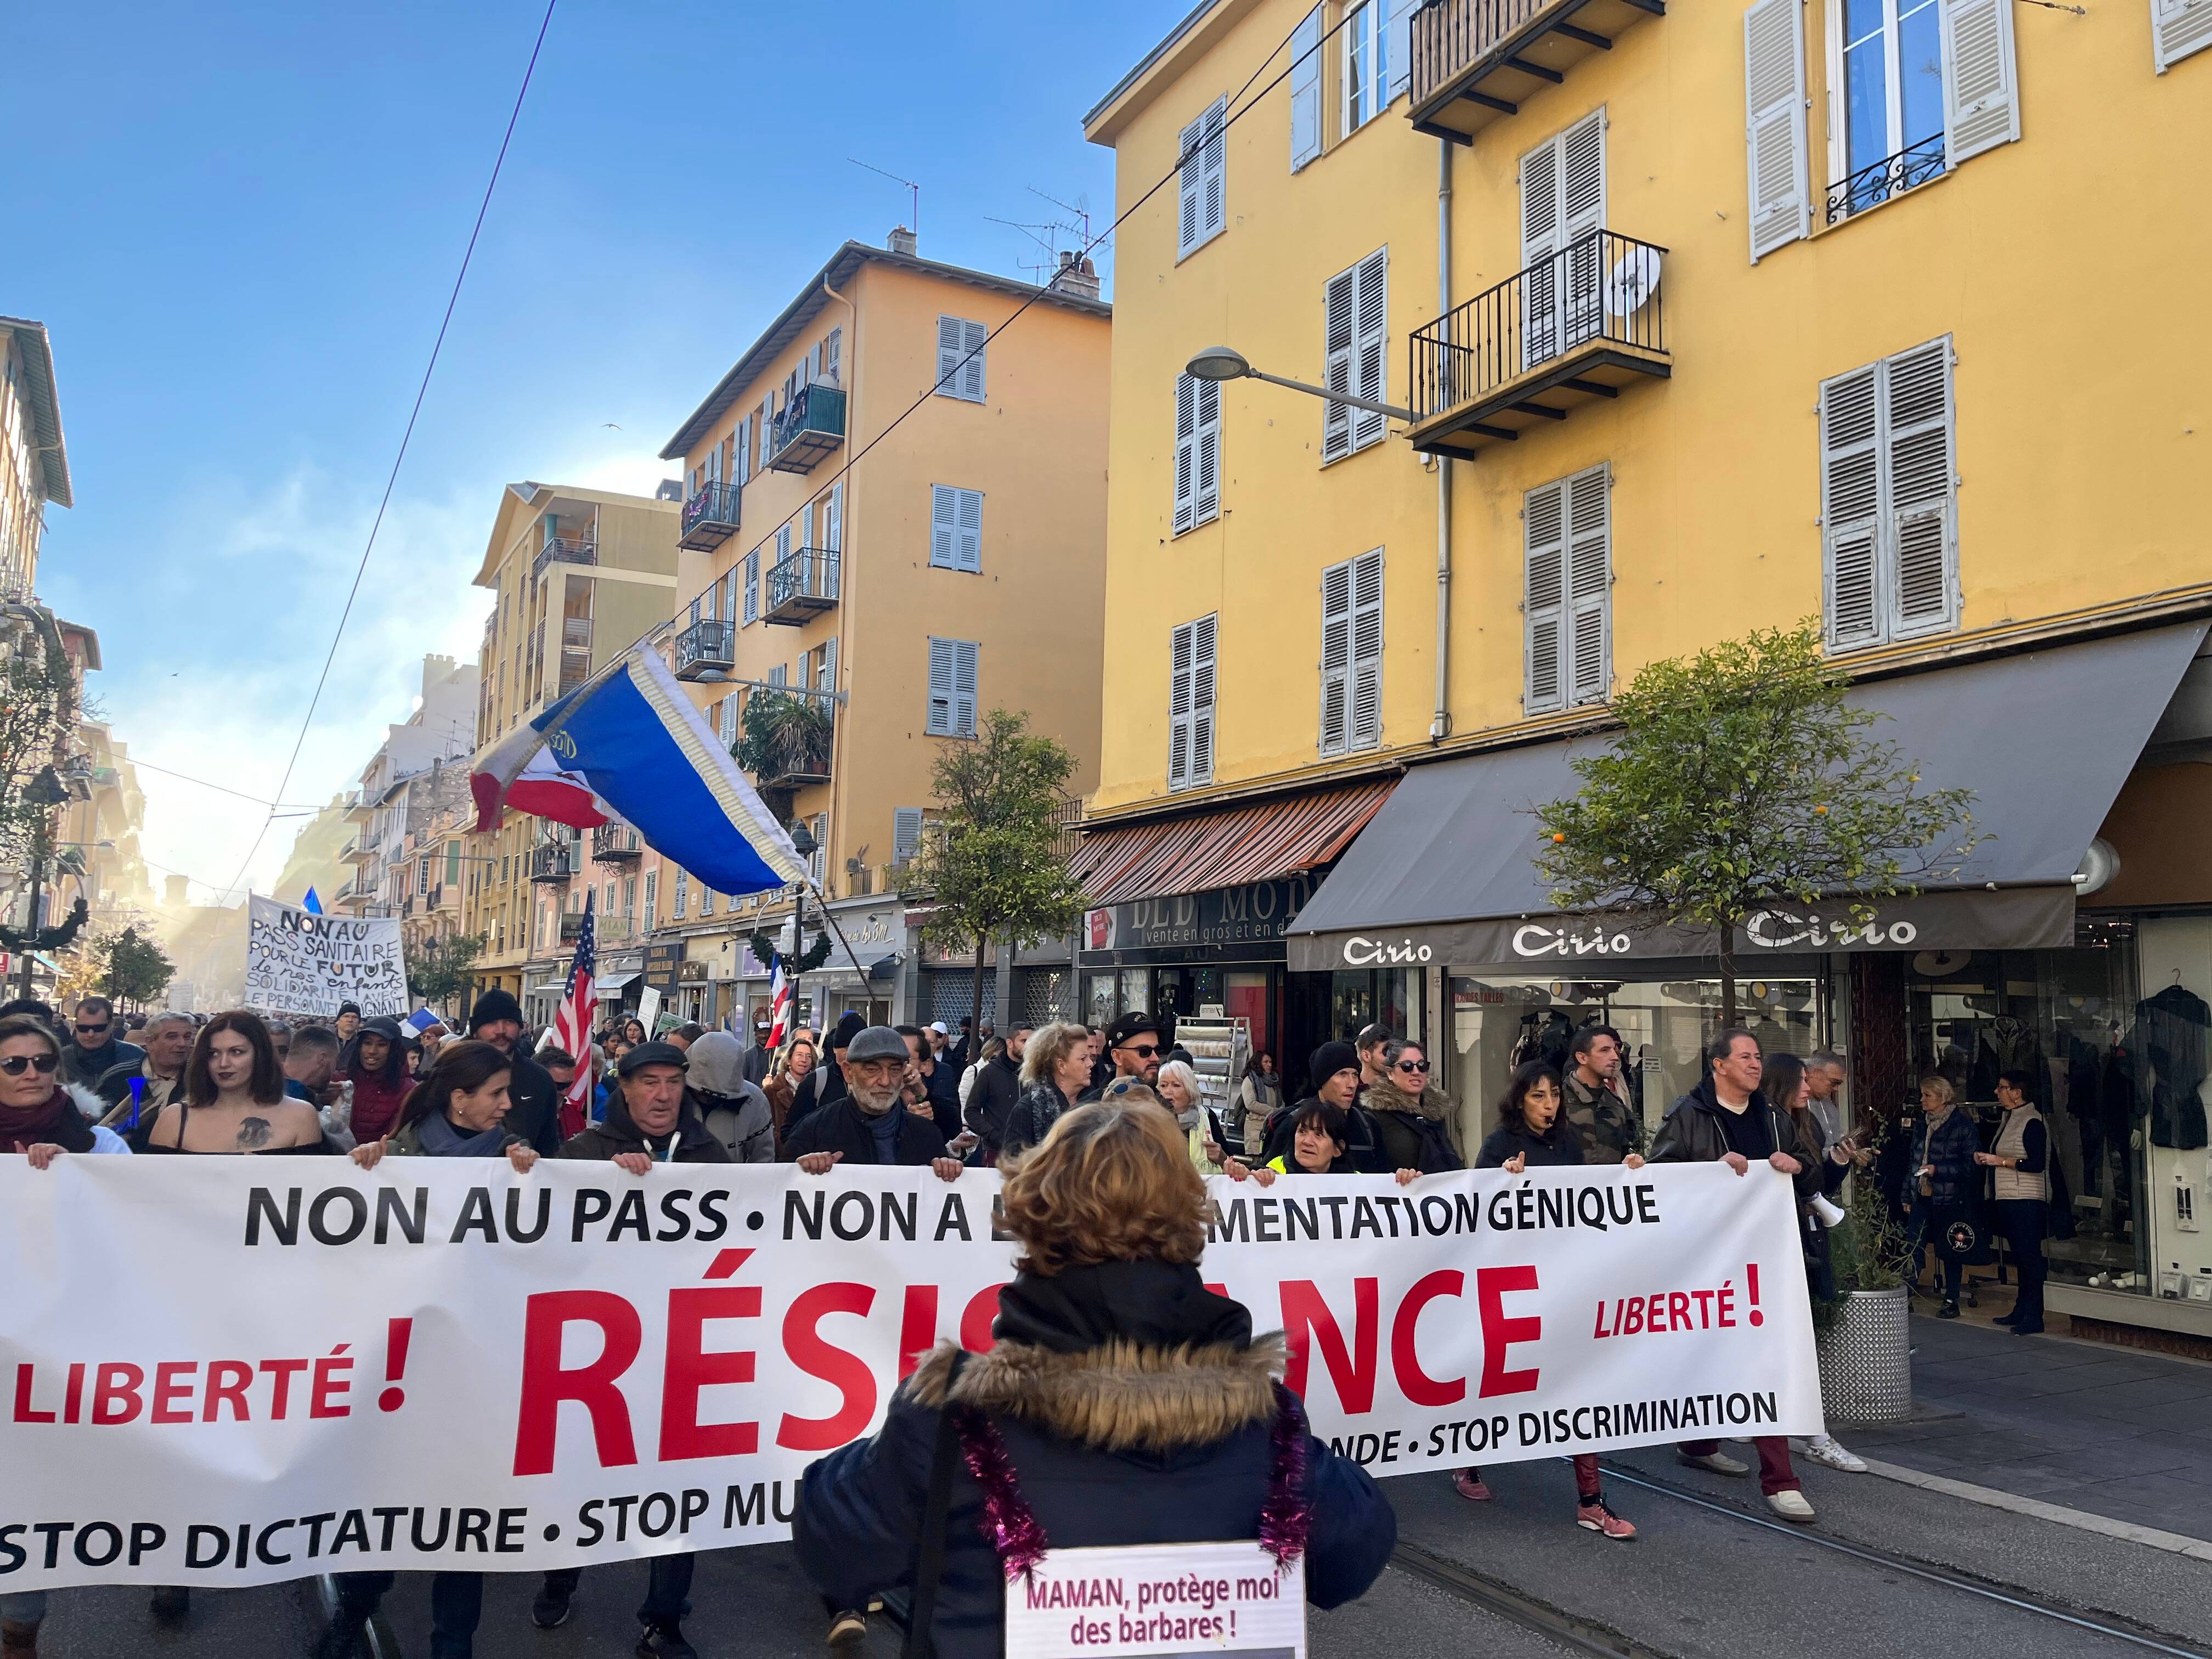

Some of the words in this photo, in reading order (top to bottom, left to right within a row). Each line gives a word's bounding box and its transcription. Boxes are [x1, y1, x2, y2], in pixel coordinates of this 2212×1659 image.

[1220, 873, 1329, 923] MOD
[251, 918, 299, 951] PASS
[304, 936, 398, 961] SANITAIRE
[281, 910, 334, 940] NON
[335, 922, 370, 941] AU
[1147, 928, 1178, 943] vente
[1183, 928, 1197, 940] en
[1203, 926, 1230, 944] gros
[1237, 923, 1249, 938] et
[1255, 923, 1271, 937] en
[1513, 924, 1632, 957] Cirio
[249, 941, 290, 964] POUR
[292, 955, 311, 970] LE
[317, 960, 399, 978] FUTUR
[1343, 936, 1432, 964] Cirio
[245, 972, 350, 1001] SOLIDARITÉ
[363, 988, 399, 1003] AVEC
[251, 958, 274, 974] de
[280, 968, 315, 983] nos
[325, 974, 403, 997] enfants
[341, 996, 404, 1016] IGNANT
[244, 1186, 428, 1246] NON
[449, 1187, 551, 1244] AU
[571, 1188, 730, 1243] PASS
[782, 1190, 918, 1242] NON
[934, 1193, 972, 1242] A
[1488, 1180, 1661, 1232] GÉNIQUE
[1594, 1280, 1737, 1340] LIBERTÉ
[13, 1343, 355, 1425] LIBERTÉ
[0, 1521, 166, 1575] STOP
[185, 1506, 528, 1569] DICTATURE
[575, 1488, 709, 1547] STOP
[1427, 1415, 1509, 1459] STOP
[1520, 1391, 1779, 1447] DISCRIMINATION
[1026, 1577, 1130, 1611] MAMAN,
[1138, 1572, 1229, 1614] protège
[1237, 1569, 1279, 1600] moi
[1070, 1615, 1111, 1645] des
[1119, 1611, 1224, 1643] barbares
